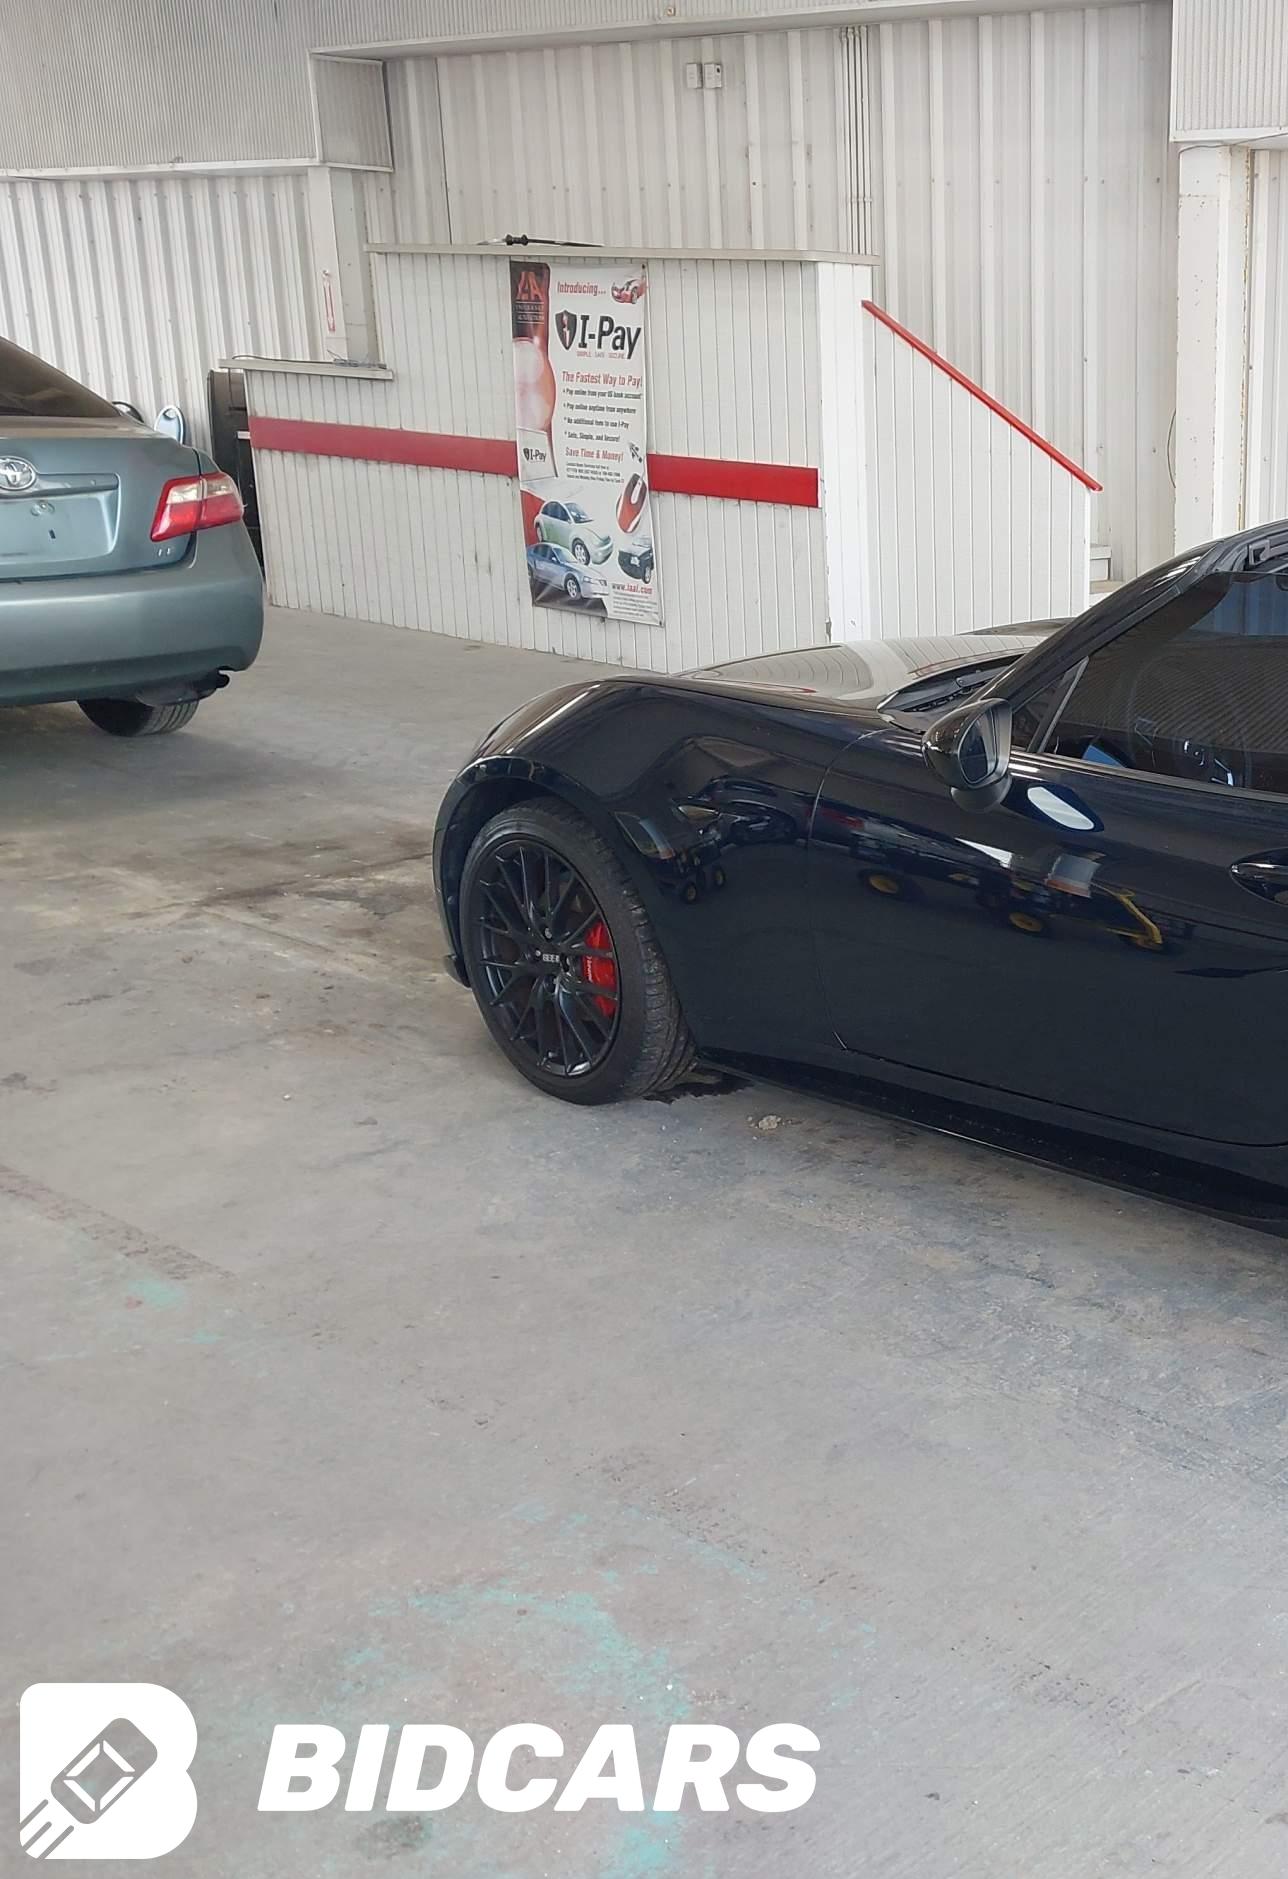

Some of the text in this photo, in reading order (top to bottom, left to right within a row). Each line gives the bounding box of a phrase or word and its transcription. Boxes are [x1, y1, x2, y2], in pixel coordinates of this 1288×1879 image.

[557, 281, 606, 296] Introducing...
[578, 314, 641, 360] I-Pay
[562, 370, 643, 389] The Fastest Way to Pay!
[530, 448, 547, 462] I-Pay
[565, 446, 624, 463] Save Time & Money!
